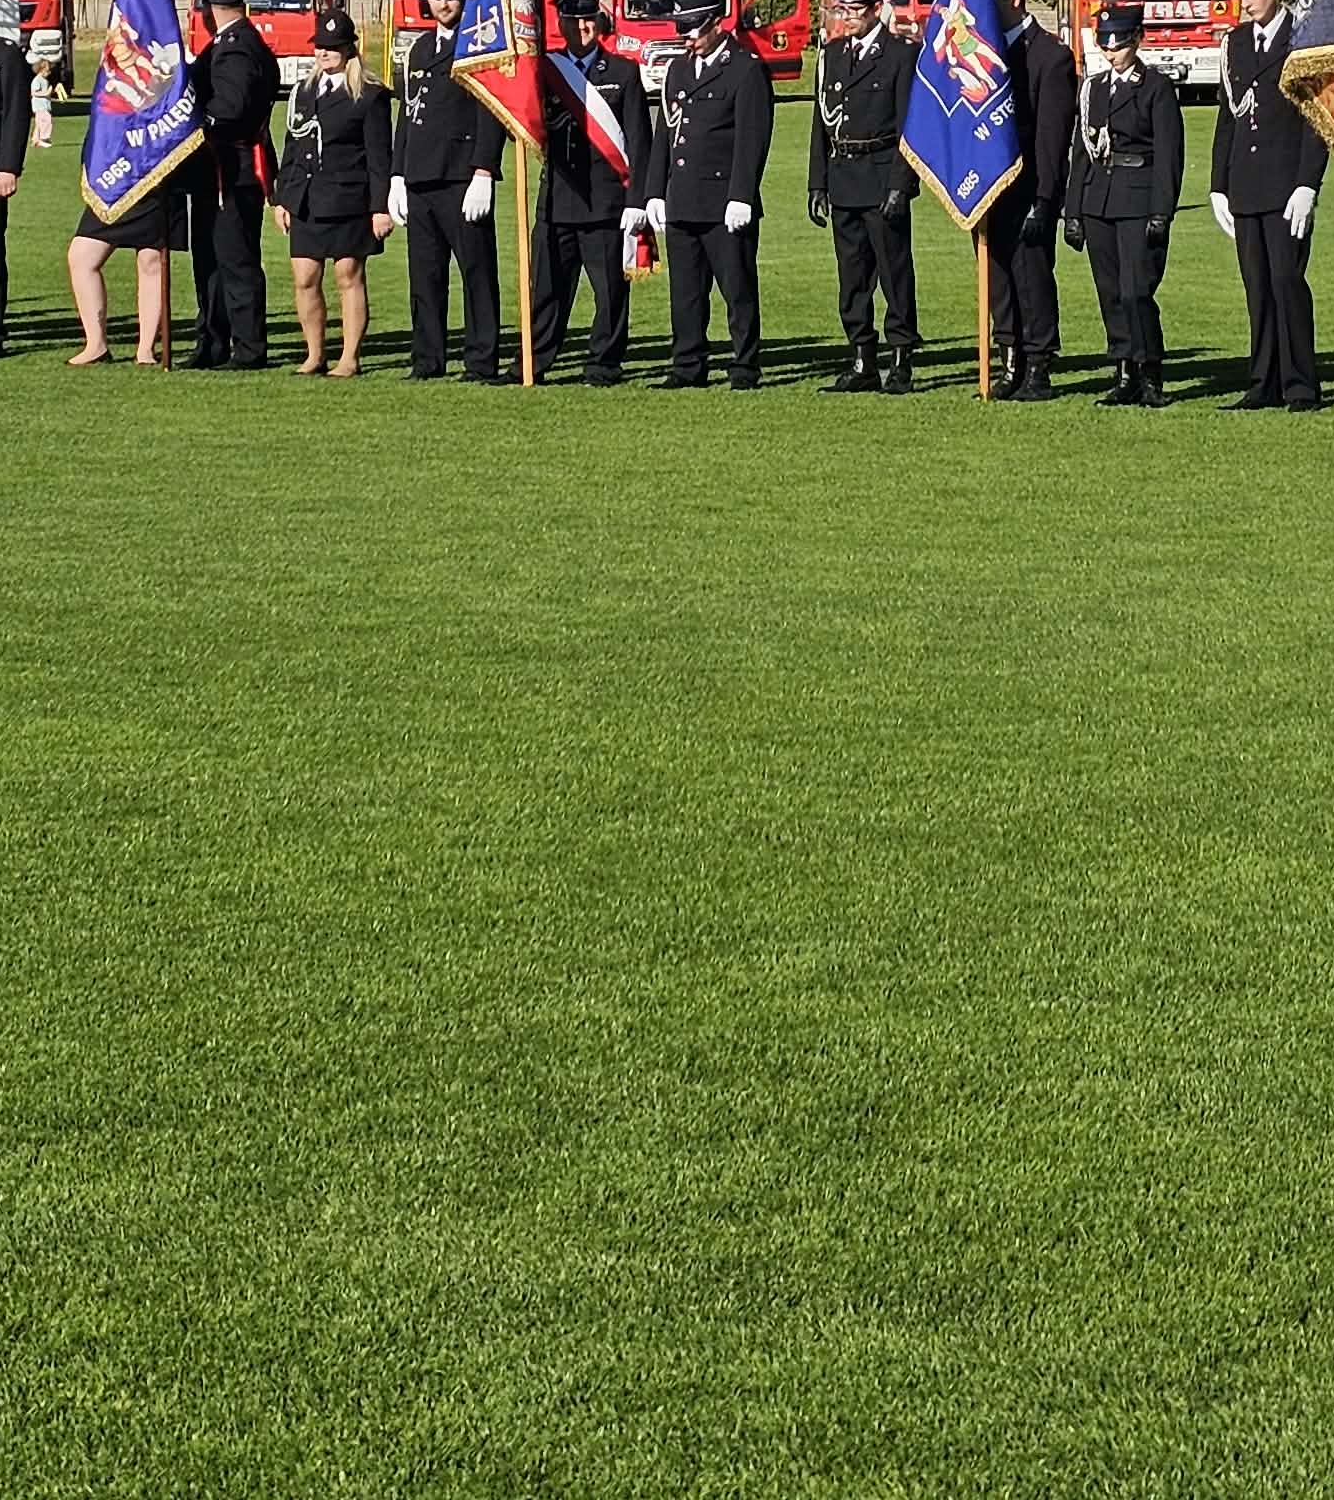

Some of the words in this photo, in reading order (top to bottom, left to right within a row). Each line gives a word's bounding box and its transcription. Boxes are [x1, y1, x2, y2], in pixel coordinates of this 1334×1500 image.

[126, 128, 145, 148] W
[973, 122, 991, 141] W
[96, 156, 132, 190] 1965
